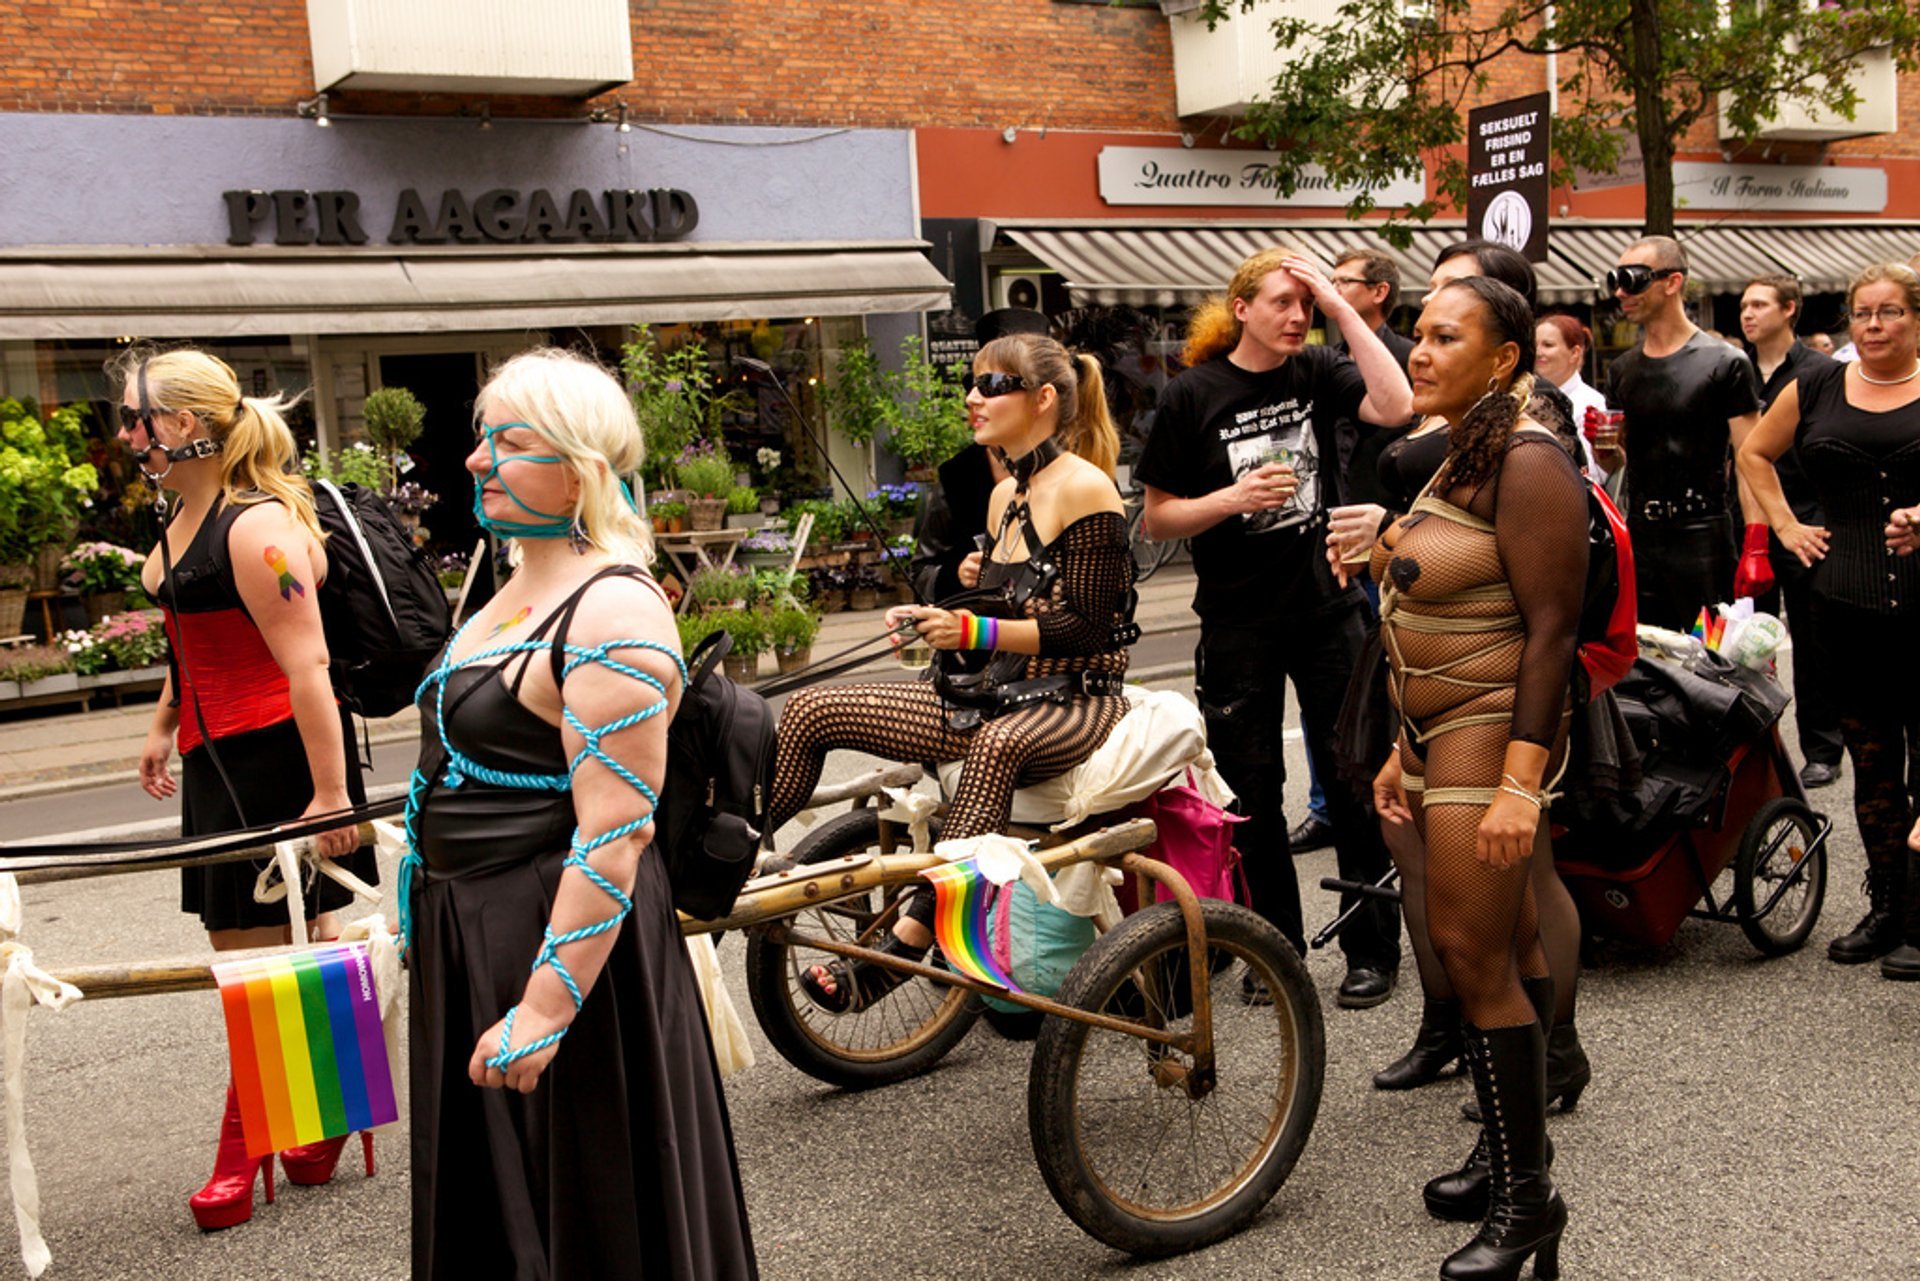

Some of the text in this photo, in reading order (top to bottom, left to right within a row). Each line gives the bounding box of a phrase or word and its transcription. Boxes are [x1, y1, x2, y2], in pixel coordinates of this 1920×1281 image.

[1479, 111, 1538, 136] SEKSUELT
[1485, 131, 1532, 152] FRISIND
[1490, 149, 1526, 168] ER EN
[1135, 160, 1231, 189] Quattro
[1471, 162, 1544, 188] FÆLLES SAG
[1710, 176, 1850, 199] Il Forno Italiano
[222, 188, 700, 246] PER AAGAARD
